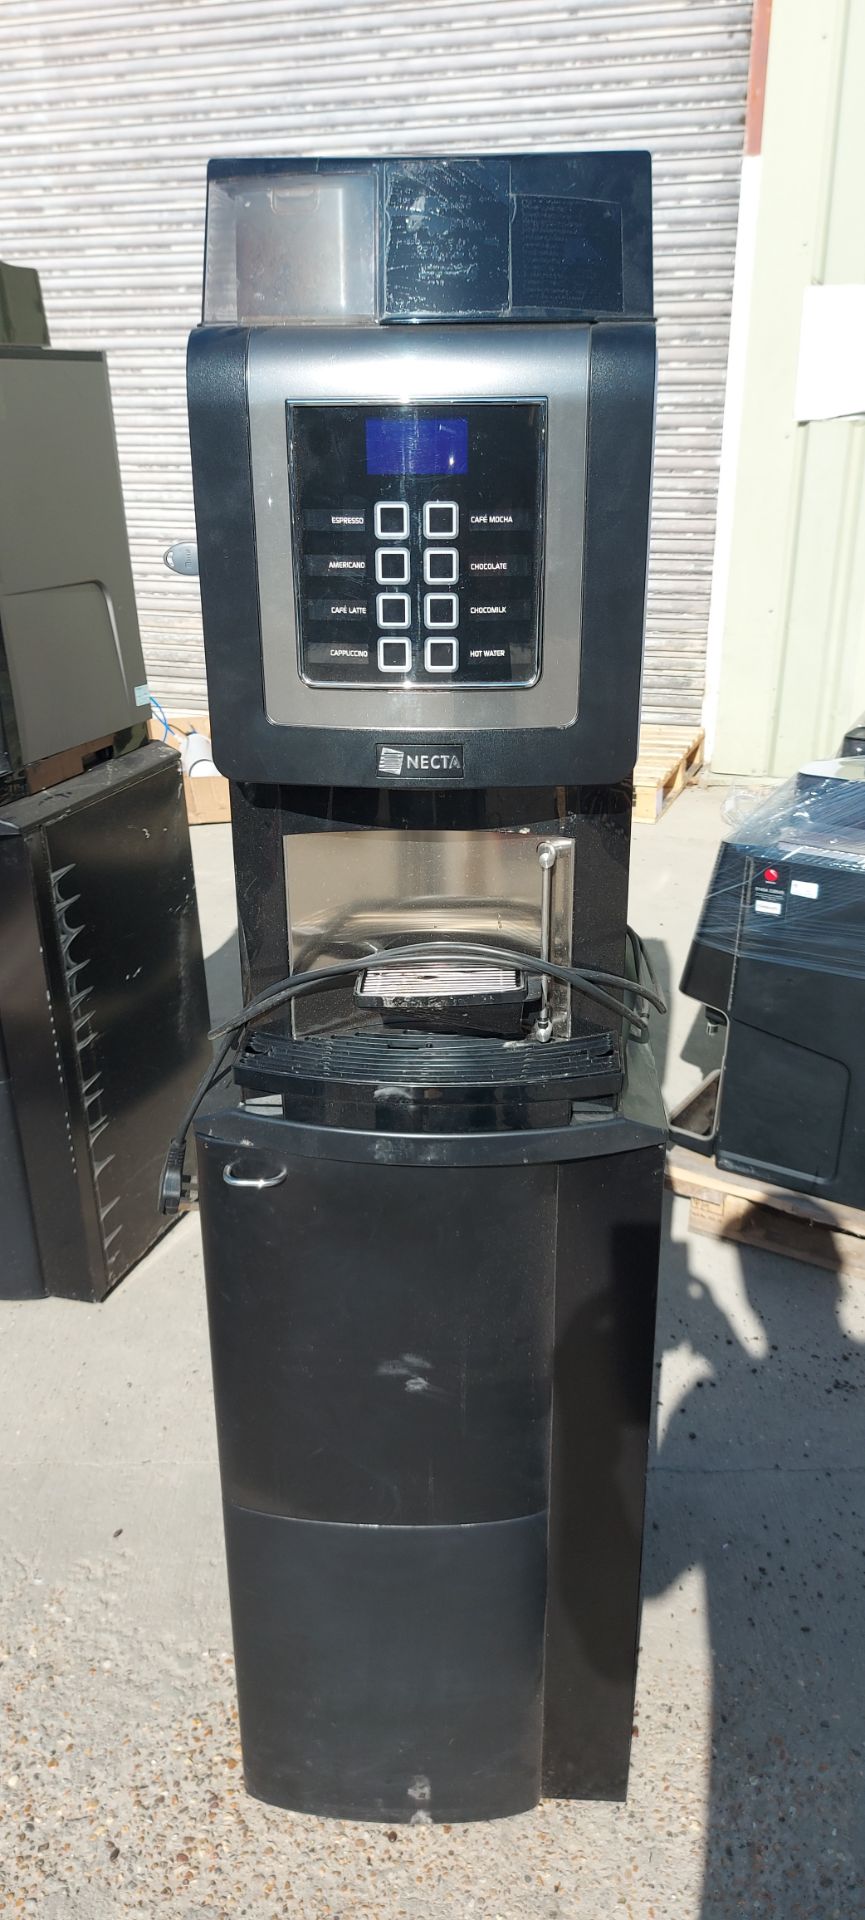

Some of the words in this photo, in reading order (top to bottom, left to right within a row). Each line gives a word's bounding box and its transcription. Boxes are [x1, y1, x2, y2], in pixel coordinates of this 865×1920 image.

[331, 516, 364, 525] ESPRESSO
[470, 514, 487, 523] CAFÉ
[489, 515, 513, 523] MOCHA
[328, 561, 366, 569] AMERICANO
[470, 562, 508, 570] CHOCOLATE
[331, 605, 347, 614] CAFÉ
[349, 606, 367, 614] LATTE
[470, 606, 507, 614] CHOCOMILK
[330, 649, 368, 658] CAPPUCCINO
[470, 649, 483, 658] HOT
[484, 649, 505, 657] WATER
[406, 755, 461, 770] NECTA
